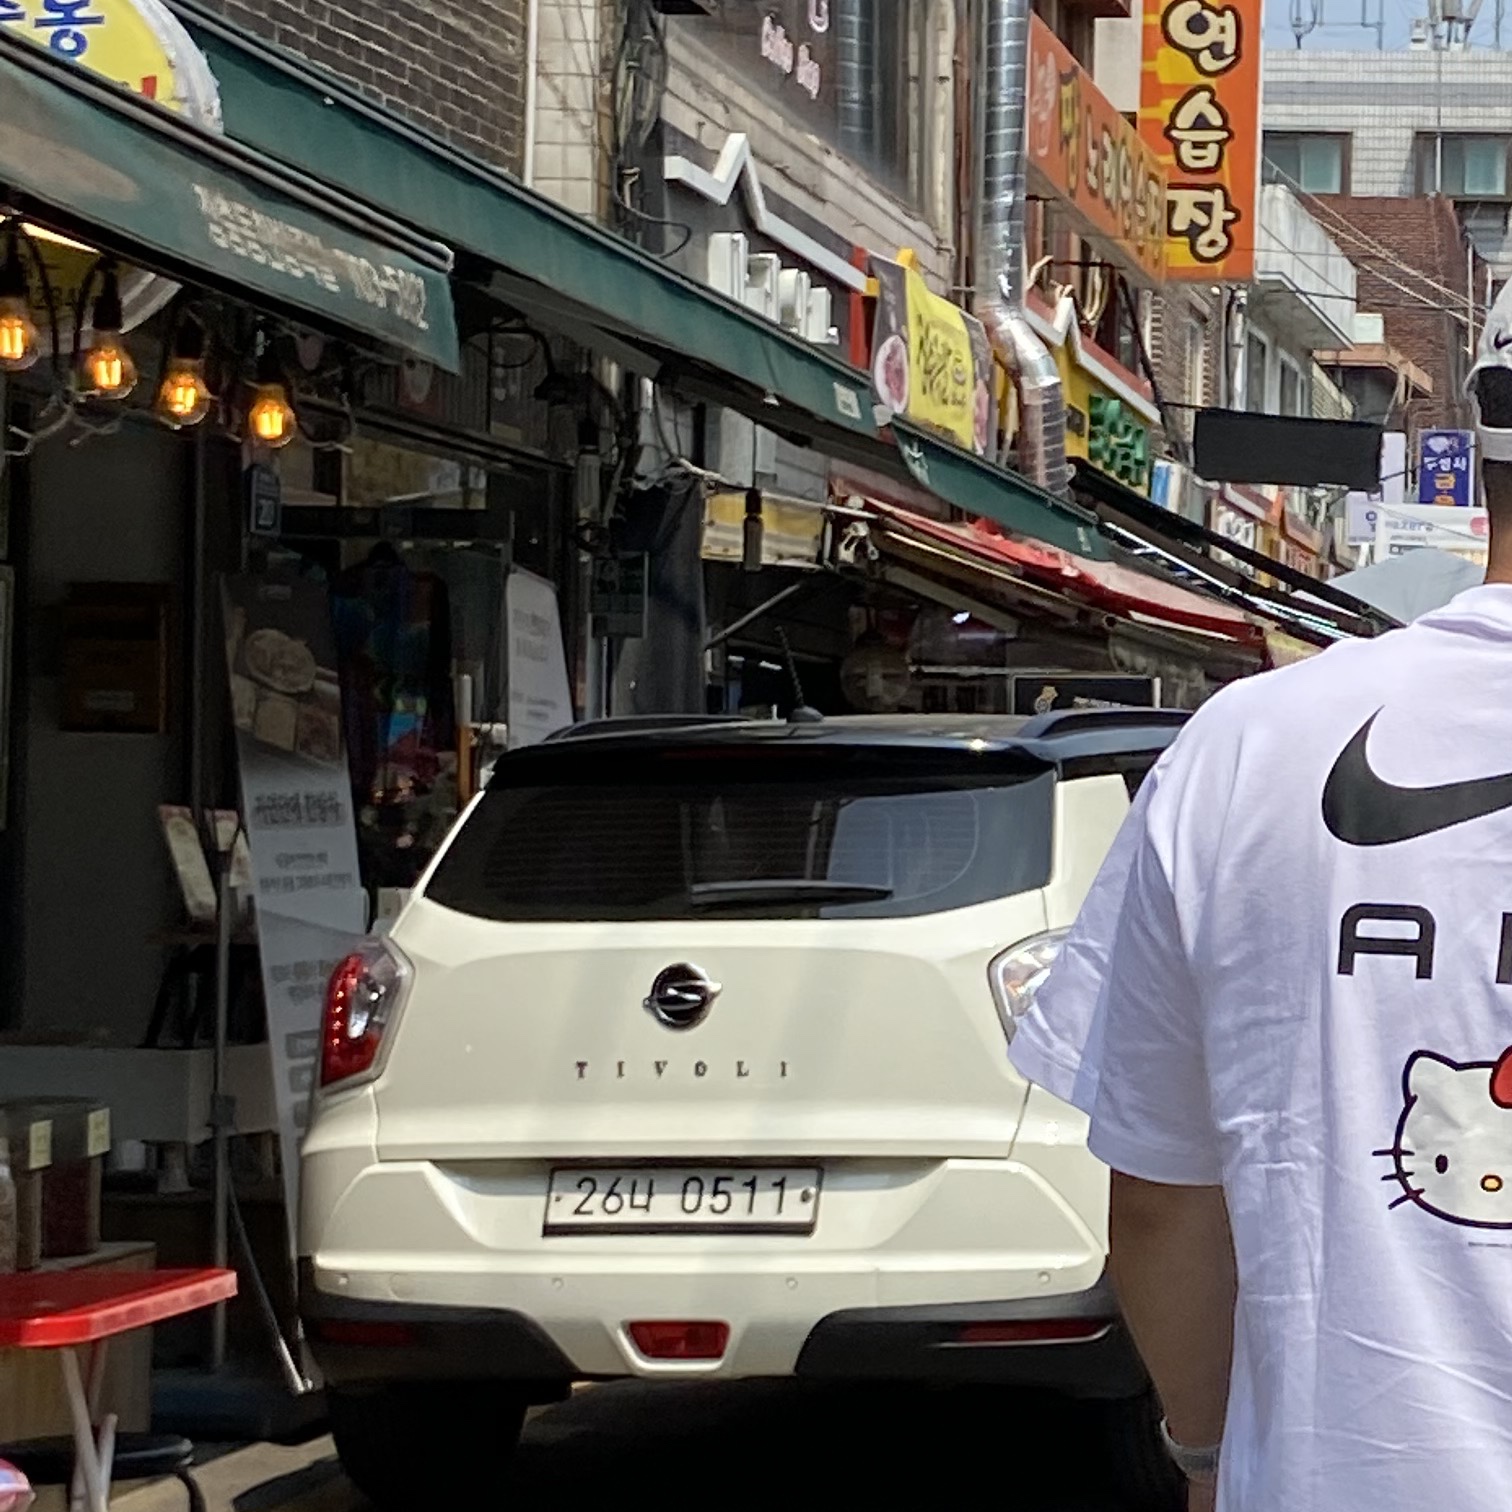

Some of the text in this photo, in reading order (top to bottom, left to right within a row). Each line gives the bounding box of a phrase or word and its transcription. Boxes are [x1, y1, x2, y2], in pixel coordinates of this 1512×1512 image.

[1162, 0, 1242, 263] 연습장
[575, 1060, 788, 1079] TIVOLI
[680, 1176, 788, 1215] 0511
